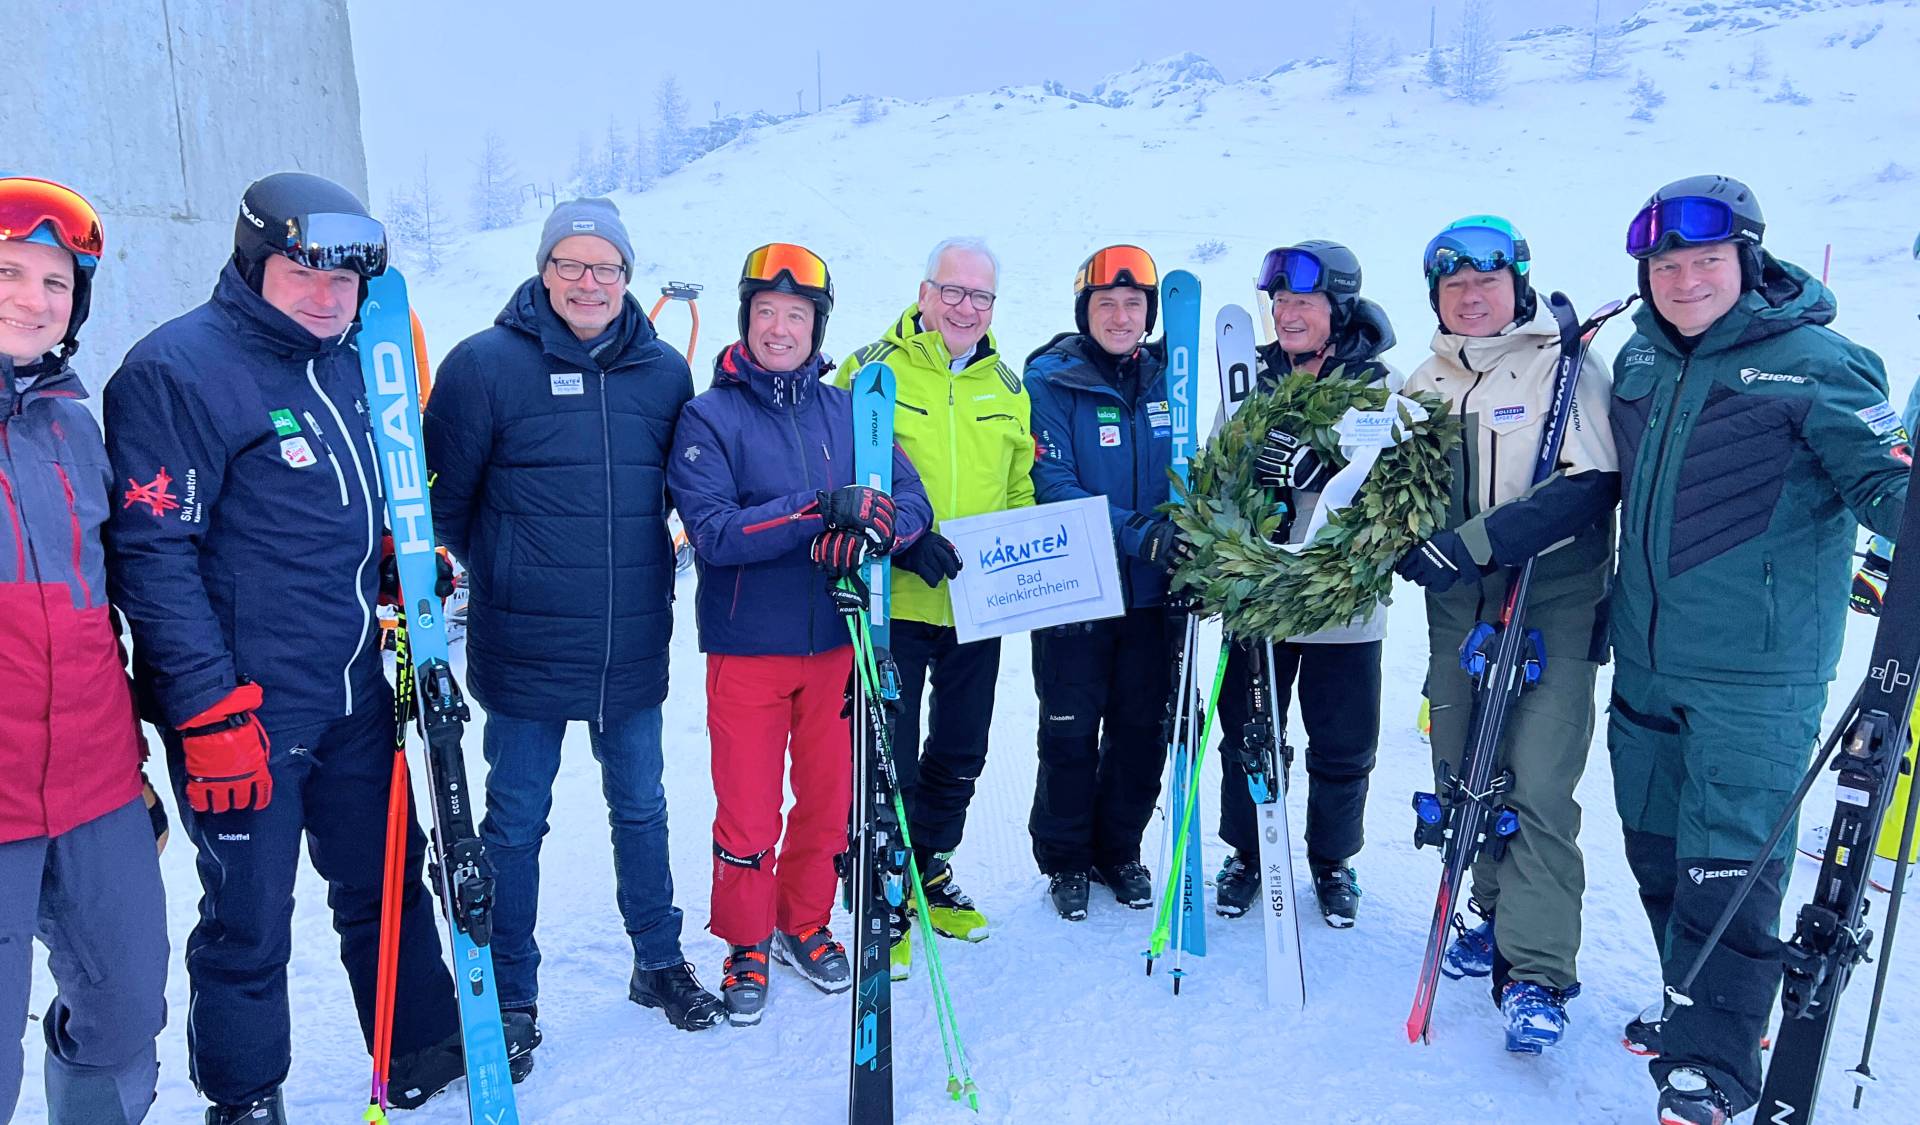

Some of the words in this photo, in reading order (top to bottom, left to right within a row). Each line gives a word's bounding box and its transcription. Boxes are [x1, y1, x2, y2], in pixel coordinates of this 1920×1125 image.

[1172, 346, 1190, 465] HEAD
[870, 409, 878, 447] ATOMIC
[372, 341, 431, 555] HEAD
[184, 468, 197, 505] Austria
[180, 506, 194, 522] Ski
[979, 524, 1068, 569] KÄRNTEN
[1421, 546, 1444, 569] SALOMON
[986, 578, 1080, 608] Kleinkirchheim
[1017, 570, 1042, 586] Bad
[217, 833, 250, 841] Schöffel
[725, 855, 753, 865] ATOMIC
[1704, 868, 1749, 879] ziene
[1183, 873, 1193, 913] SPEED
